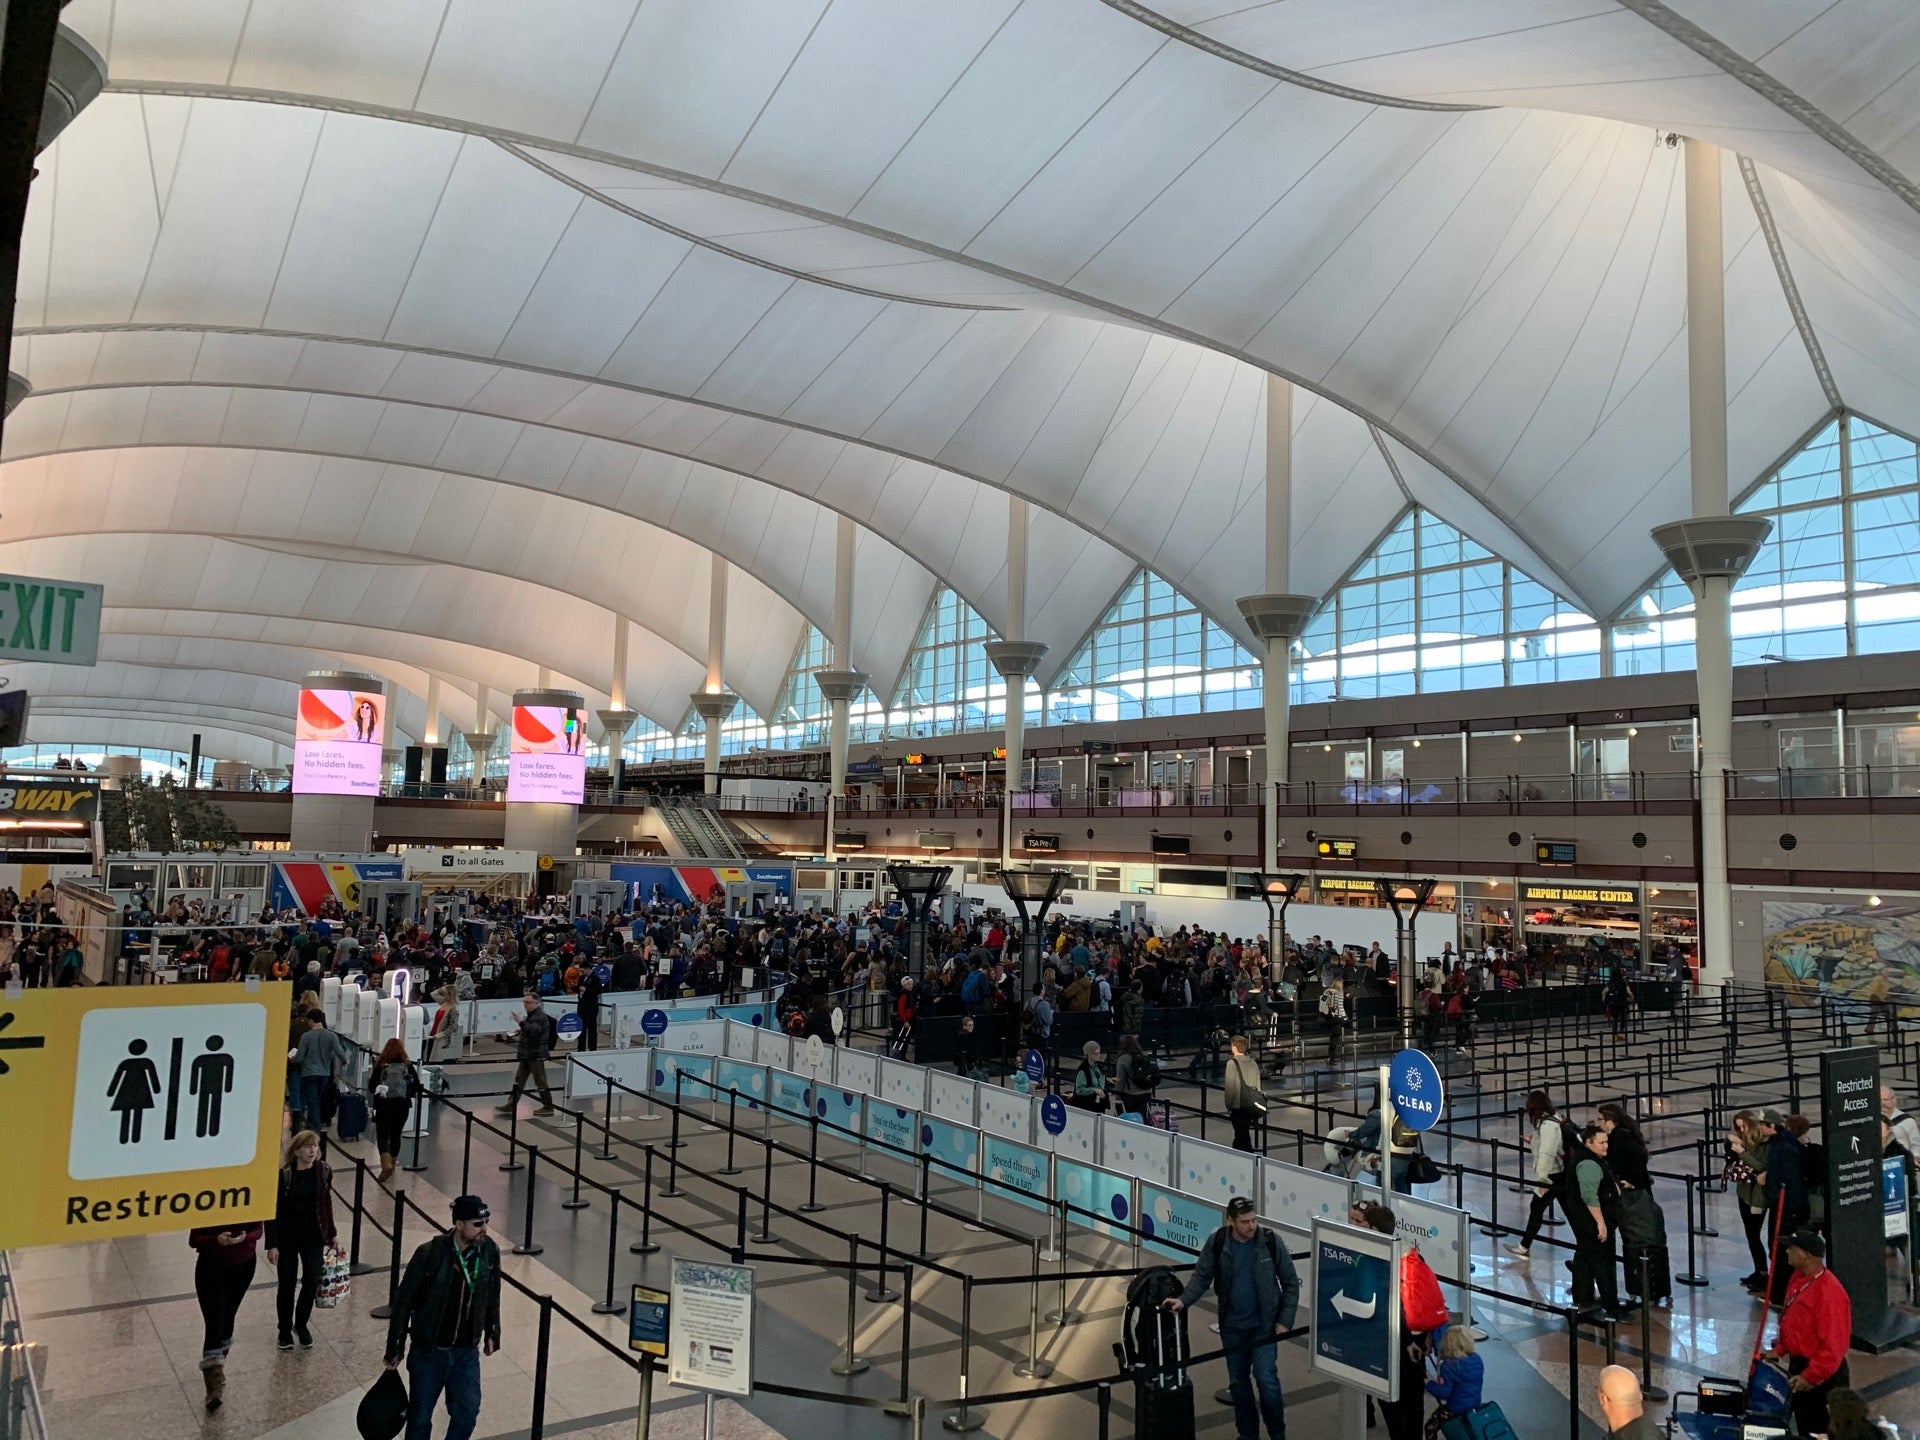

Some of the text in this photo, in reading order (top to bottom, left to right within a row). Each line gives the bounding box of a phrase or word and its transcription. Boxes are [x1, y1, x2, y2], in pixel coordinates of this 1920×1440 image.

[305, 750, 345, 759] Low fares.
[316, 760, 346, 768] hidden
[347, 761, 366, 769] fees.
[535, 762, 556, 770] fares.
[531, 771, 557, 779] hidden
[558, 772, 574, 780] fees.
[1029, 839, 1039, 847] TSA
[457, 857, 504, 866] to all Gates
[1320, 880, 1347, 889] AIRPORT
[1347, 880, 1375, 890] BAGGAGE
[1527, 888, 1634, 902] AIRPORT BAGGAGE CENTER
[1837, 1075, 1873, 1094] Restricted
[1398, 1094, 1433, 1113] CLEAR
[1843, 1098, 1869, 1112] Access
[991, 1153, 1041, 1180] Speed through
[999, 1170, 1015, 1185] with
[1021, 1179, 1032, 1191] tap
[66, 1186, 251, 1225] Restroom
[1167, 1209, 1199, 1231] You are
[1395, 1217, 1432, 1239] elcome
[1166, 1229, 1199, 1248] your ID
[1323, 1247, 1353, 1265] TSA Pre
